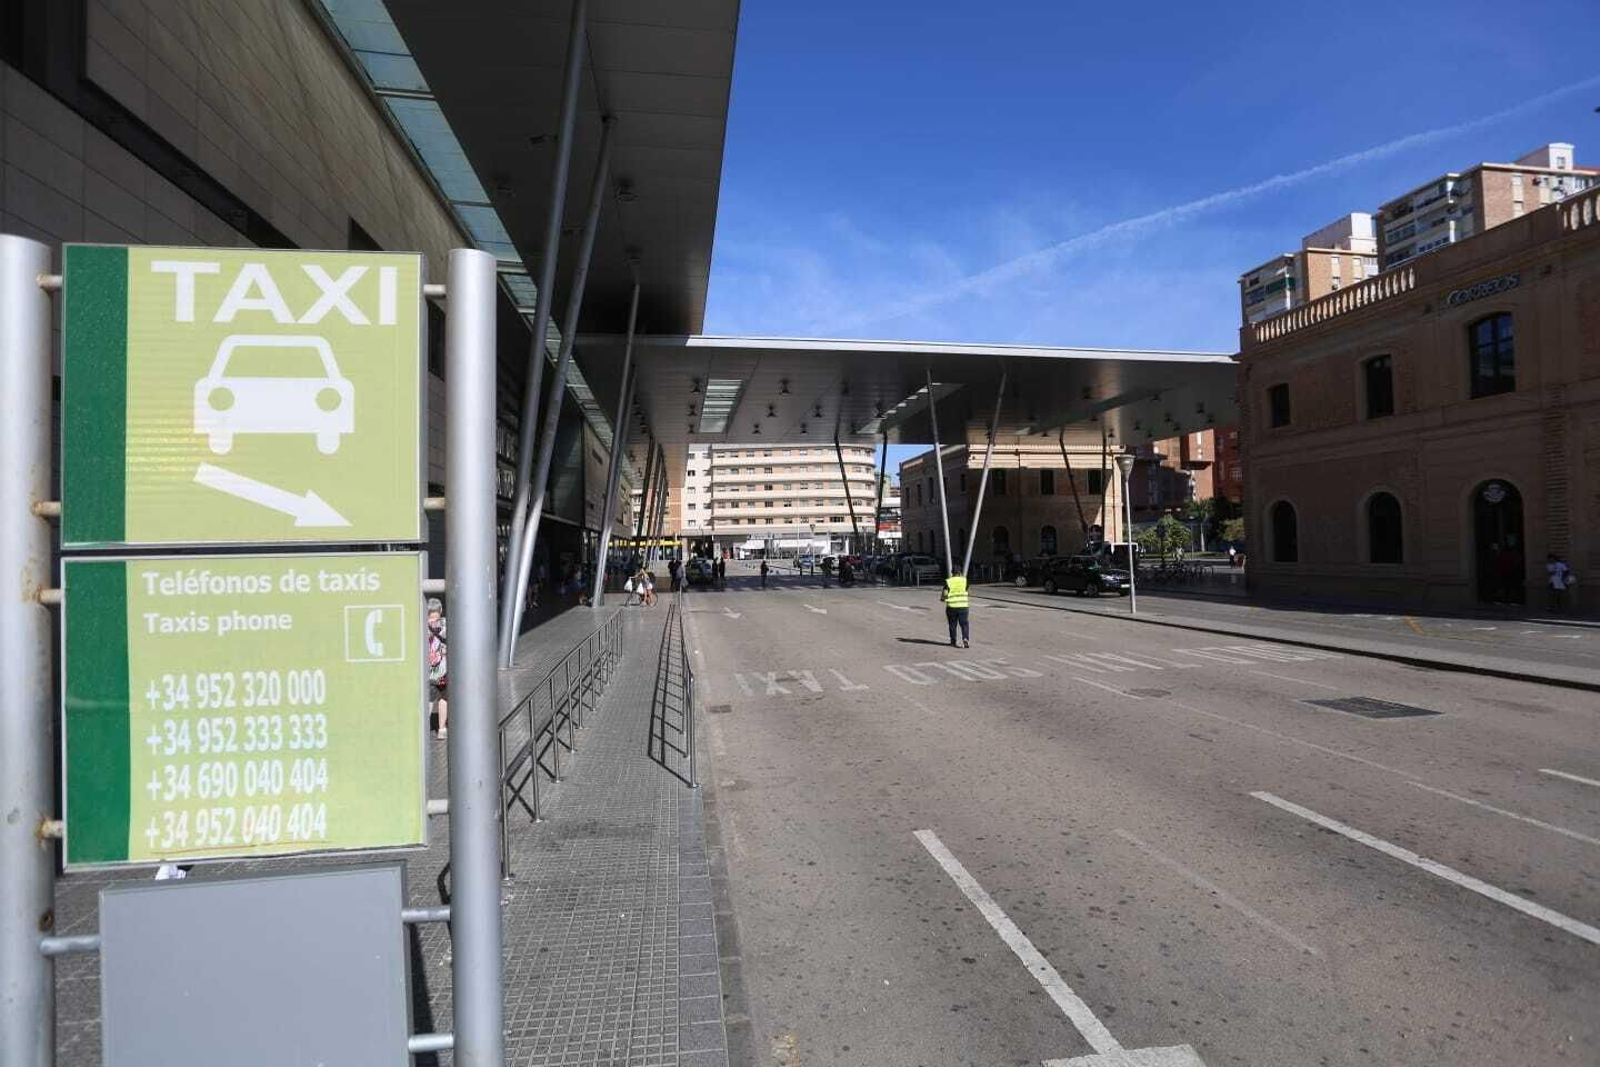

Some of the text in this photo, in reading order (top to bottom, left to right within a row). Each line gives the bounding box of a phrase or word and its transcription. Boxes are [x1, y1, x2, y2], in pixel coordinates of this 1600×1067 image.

[150, 259, 399, 326] TAXI
[142, 568, 381, 596] Teléfonos de taxis
[142, 609, 293, 637] Taxis phone
[145, 669, 327, 711] +34 952 320 000
[146, 714, 329, 756] +34 952 333 333
[146, 758, 330, 802] +34 690 040 404
[145, 802, 328, 850] +34 952 040 404
